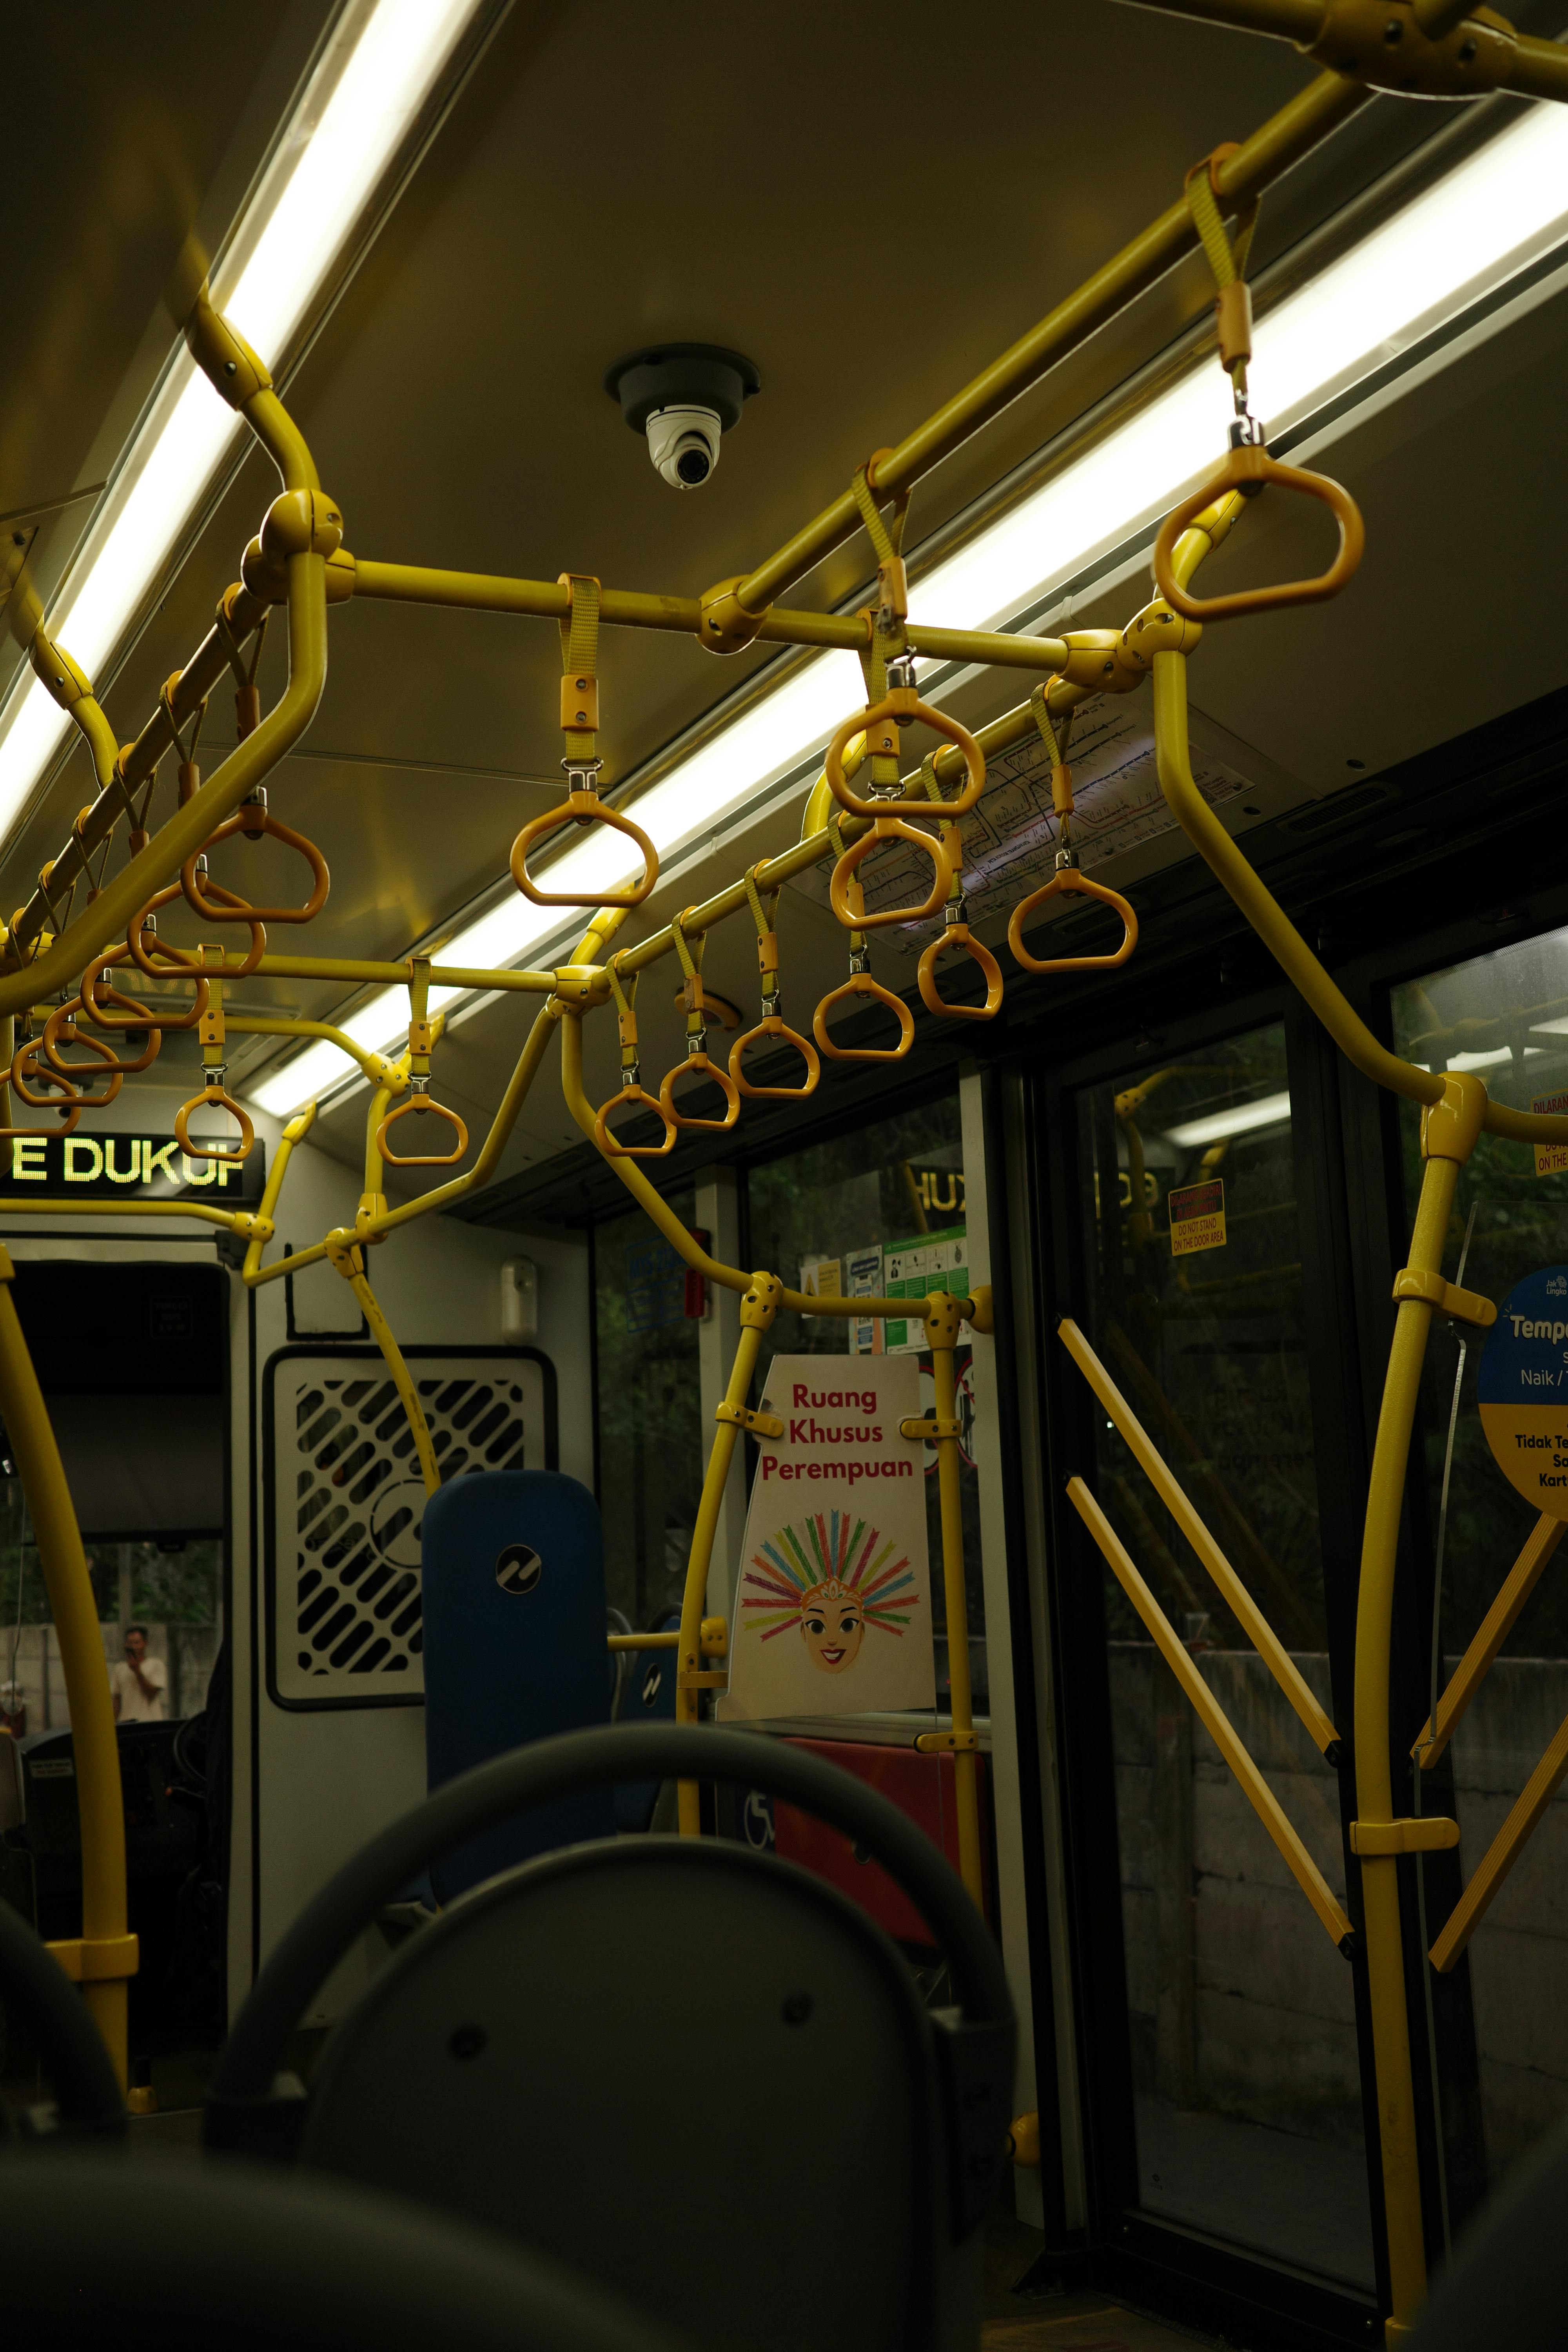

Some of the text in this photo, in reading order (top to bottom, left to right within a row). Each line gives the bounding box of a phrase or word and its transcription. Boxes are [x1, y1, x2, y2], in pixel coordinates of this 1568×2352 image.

[1539, 1152, 1567, 1171] ON THE
[1179, 1218, 1216, 1236] DO NOT STAND
[1174, 1230, 1223, 1251] ON THE DOOR AREA
[1546, 1287, 1567, 1296] Lingko
[1510, 1315, 1568, 1345] Temp
[1521, 1369, 1554, 1386] Naik
[793, 1384, 877, 1414] Ruang
[789, 1418, 883, 1444] Khusus
[1515, 1434, 1552, 1448] Tidak
[762, 1456, 913, 1485] Perempuan
[1539, 1474, 1568, 1486] Kart
